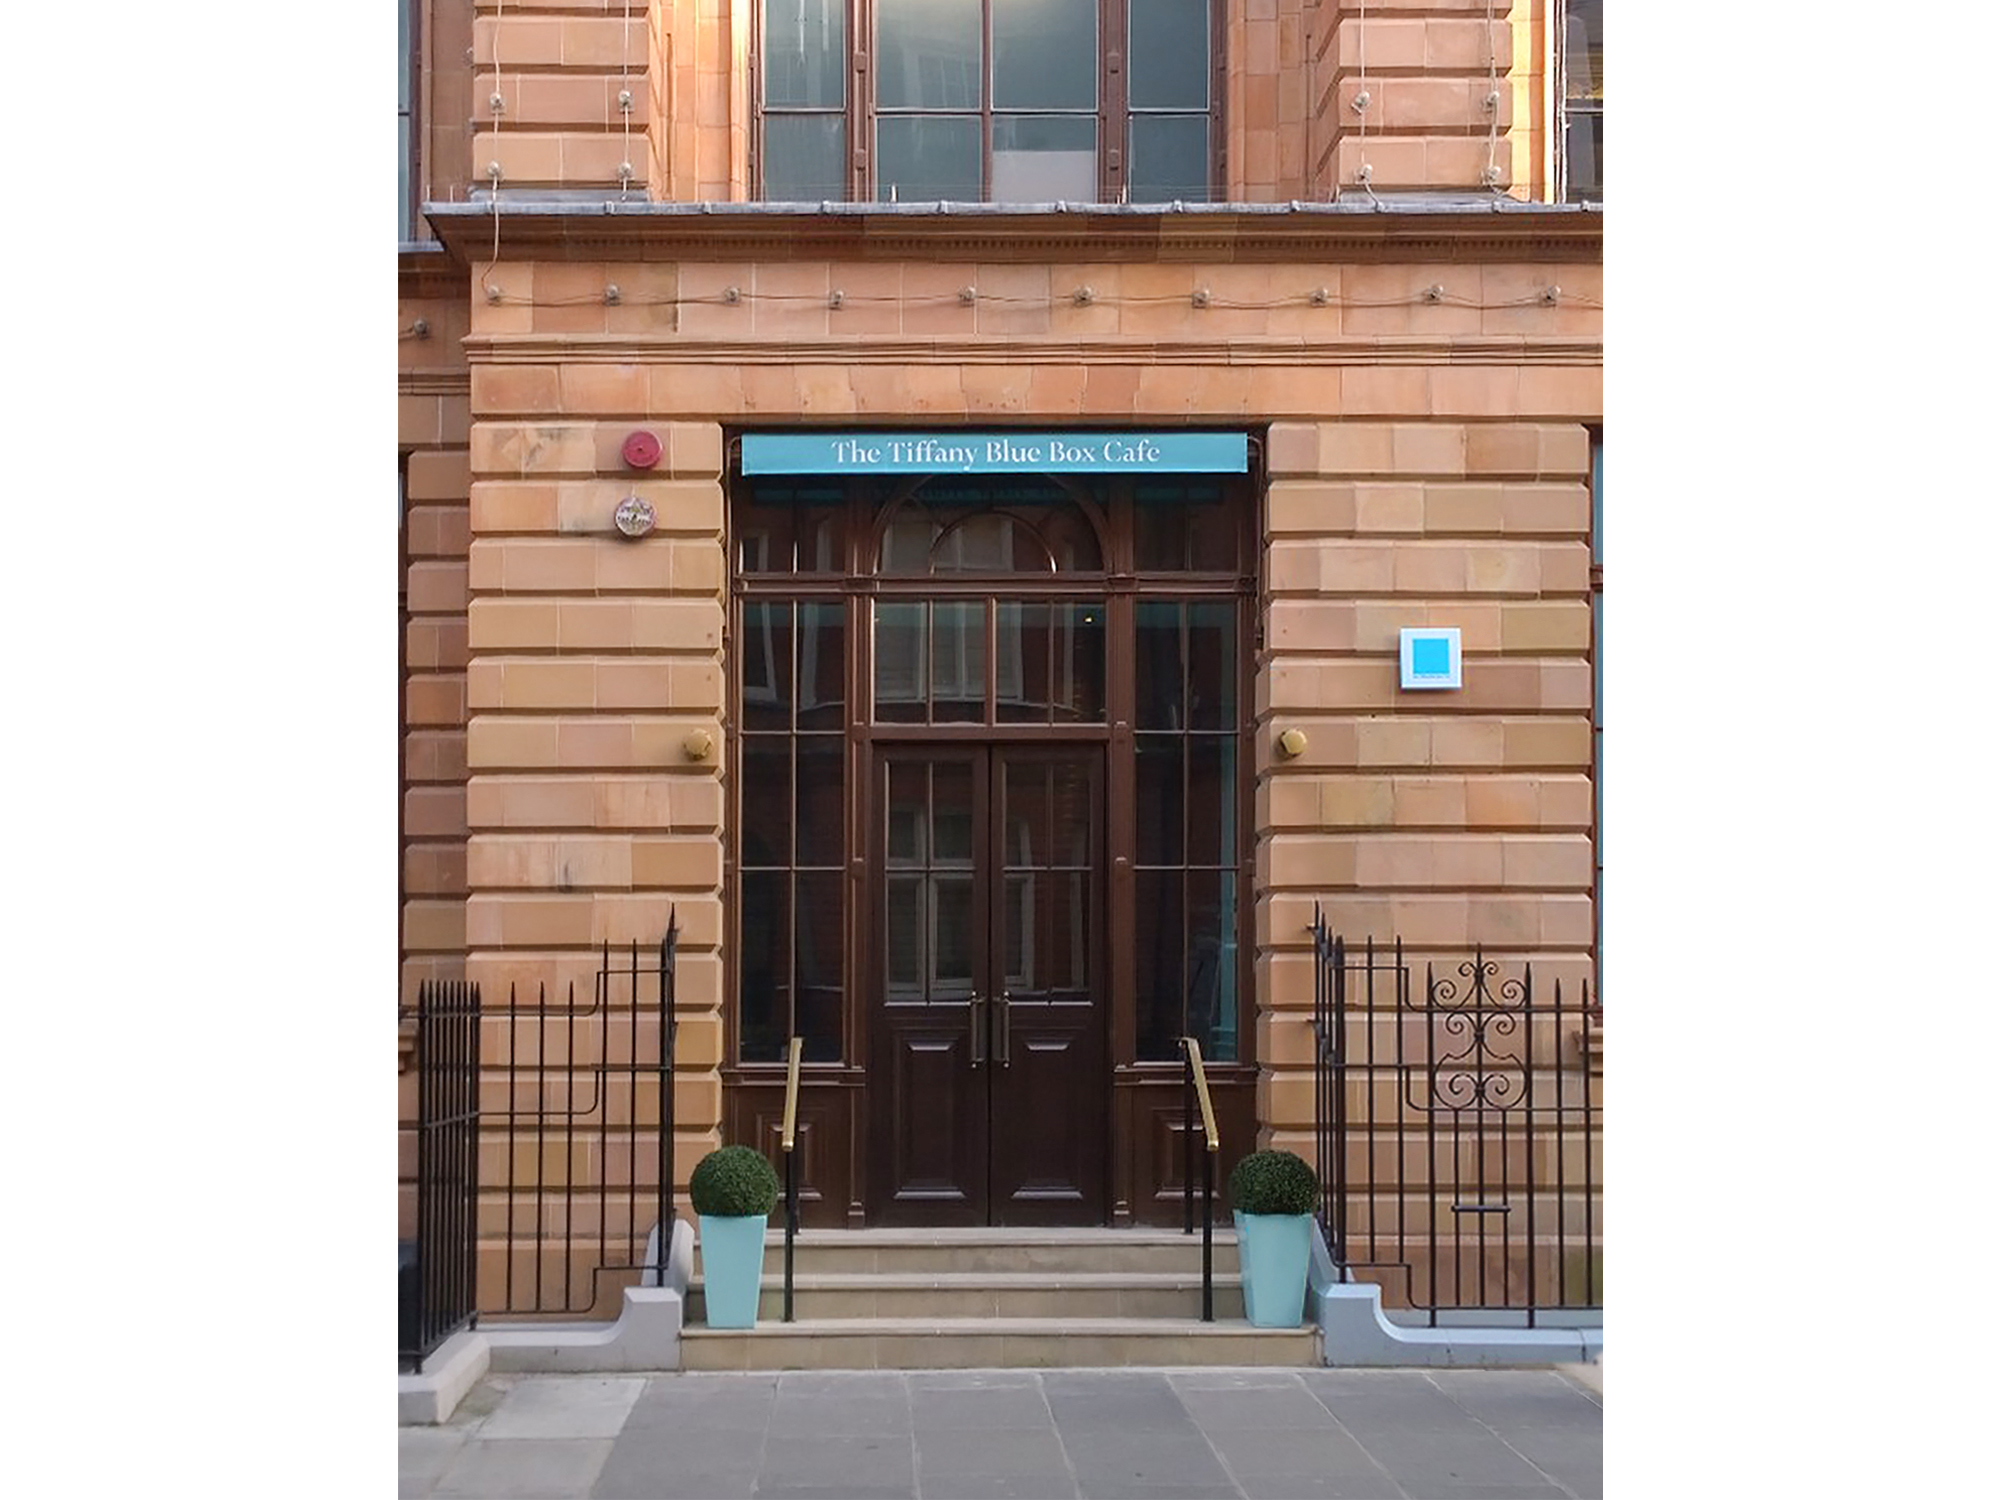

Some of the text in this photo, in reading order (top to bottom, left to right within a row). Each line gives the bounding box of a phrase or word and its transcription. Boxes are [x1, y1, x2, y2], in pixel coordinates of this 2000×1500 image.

[831, 438, 1161, 470] The Tiffany Blue Box Cafe
